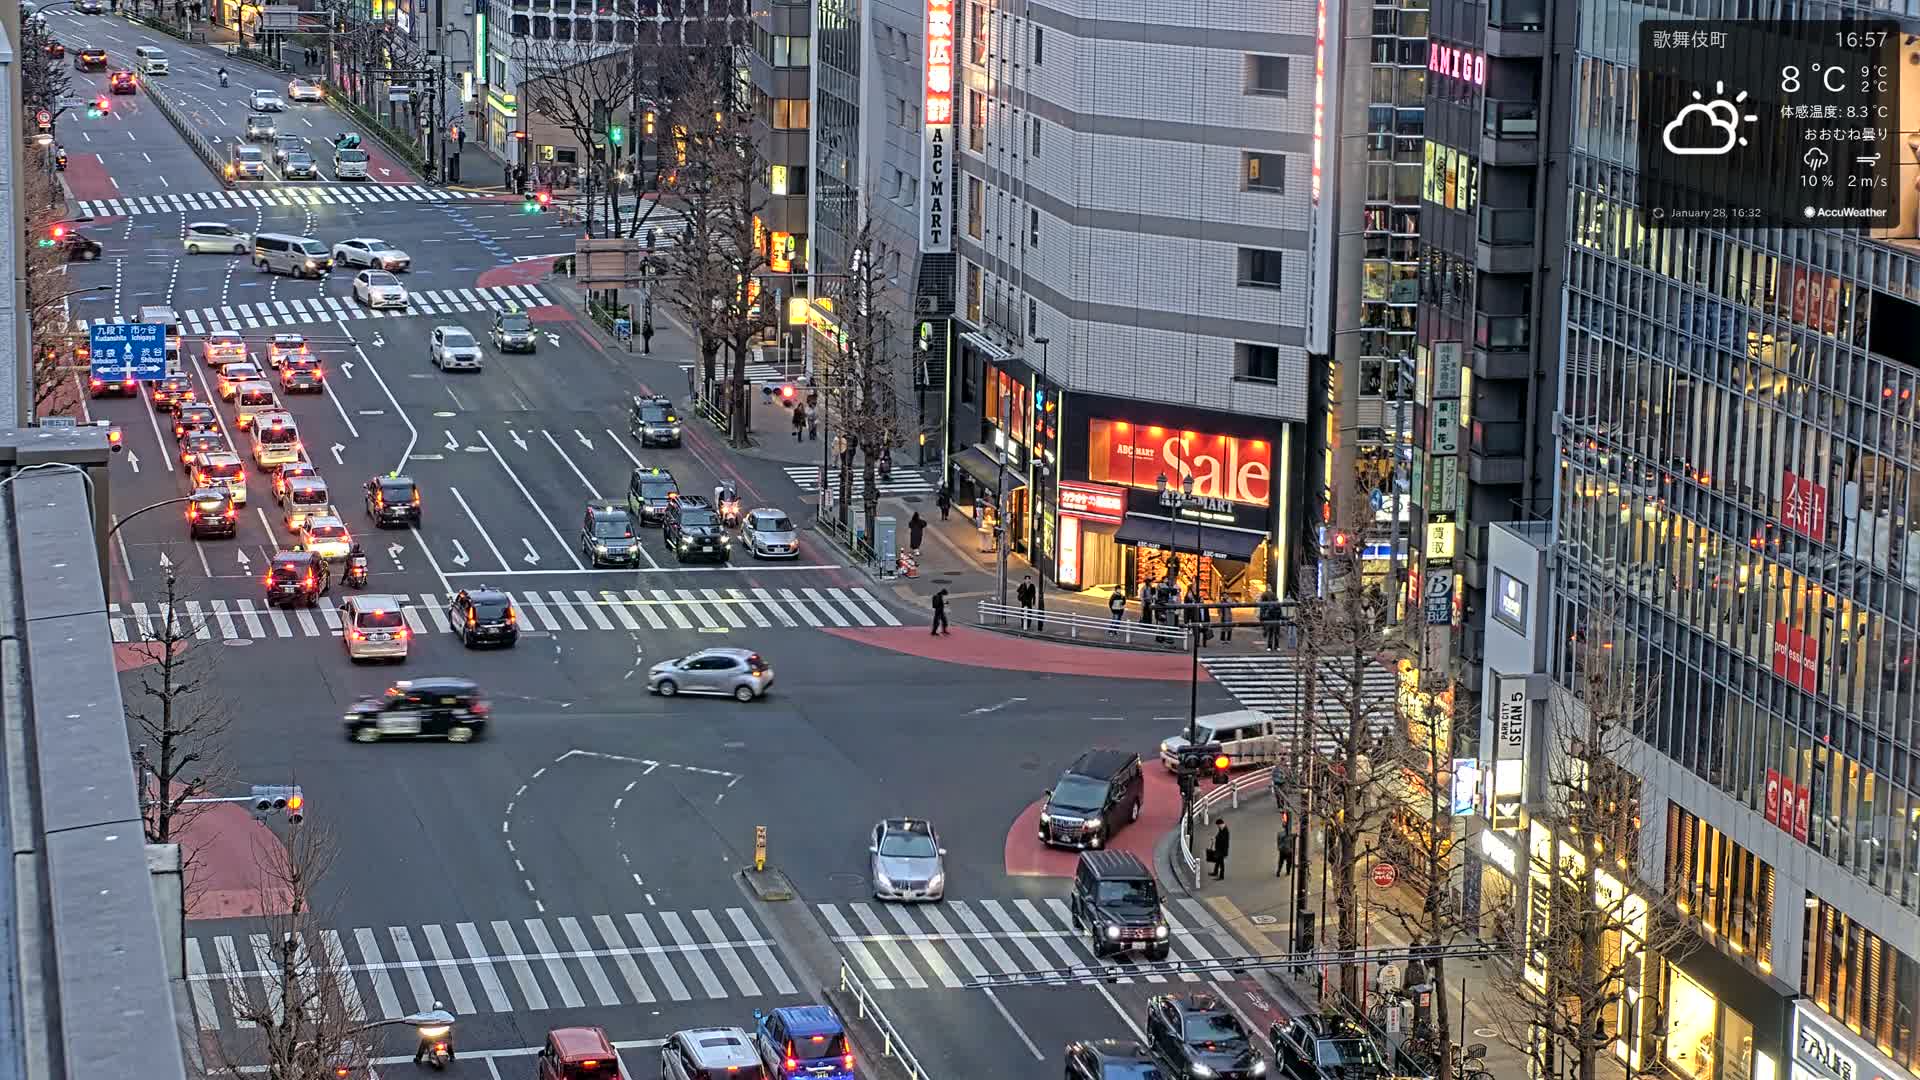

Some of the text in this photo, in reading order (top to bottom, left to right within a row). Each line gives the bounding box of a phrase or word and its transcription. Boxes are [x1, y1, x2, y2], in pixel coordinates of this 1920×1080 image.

[1429, 43, 1484, 85] AMIGO
[930, 127, 944, 244] ABC-MART
[97, 326, 125, 335] 九段下
[141, 347, 162, 357] 渋谷
[1117, 444, 1154, 456] ABCMART
[1162, 436, 1269, 502] Sale
[1435, 514, 1447, 523] 7F
[1787, 483, 1822, 531] 会計
[1432, 527, 1445, 554] 買取
[1774, 641, 1816, 671] professiona
[1500, 702, 1510, 740] PARK CITY
[1509, 691, 1524, 746] ISETAN 5
